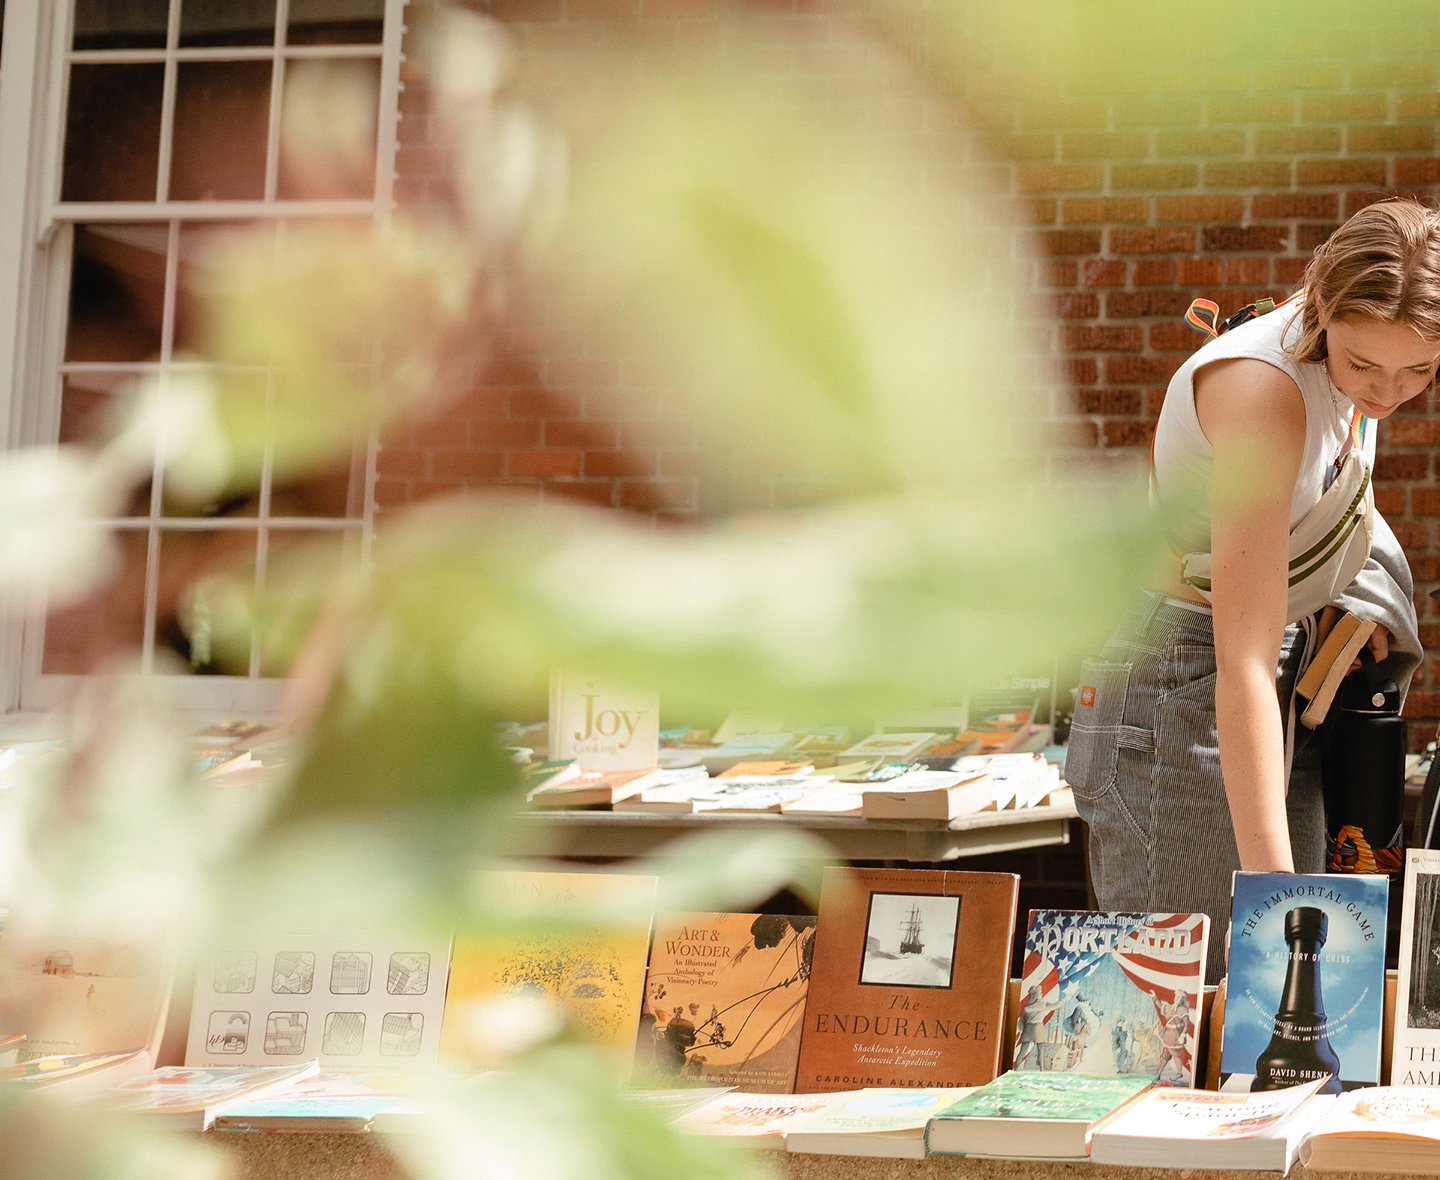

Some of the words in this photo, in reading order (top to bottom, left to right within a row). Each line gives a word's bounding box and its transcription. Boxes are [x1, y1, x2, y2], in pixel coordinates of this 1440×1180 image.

[1241, 908, 1263, 938] THE
[1263, 885, 1342, 910] IMMORTAL
[1346, 902, 1375, 941] GAME
[678, 926, 708, 940] ART
[710, 929, 721, 941] &
[1040, 924, 1192, 956] PORTLAND
[665, 941, 730, 958] WONDER
[684, 959, 717, 967] Illustrated
[1265, 951, 1271, 959] A
[1274, 951, 1308, 961] HISTORY
[1312, 953, 1321, 961] OF
[1325, 954, 1350, 964] CHESS
[674, 968, 706, 977] Anthology
[667, 976, 697, 986] Visionary
[698, 978, 718, 987] Poetry
[889, 995, 920, 1010] The
[815, 1014, 988, 1041] ENDURANCE
[852, 1043, 900, 1054] Shackleton's
[902, 1046, 942, 1058] Legendary
[857, 1054, 893, 1065] Antarctic
[895, 1056, 937, 1067] Expedition
[1270, 1068, 1296, 1077] DAVID
[1300, 1070, 1329, 1079] SHENK
[816, 1074, 883, 1085] CAROLINE
[890, 1078, 973, 1088] ALEXANDER
